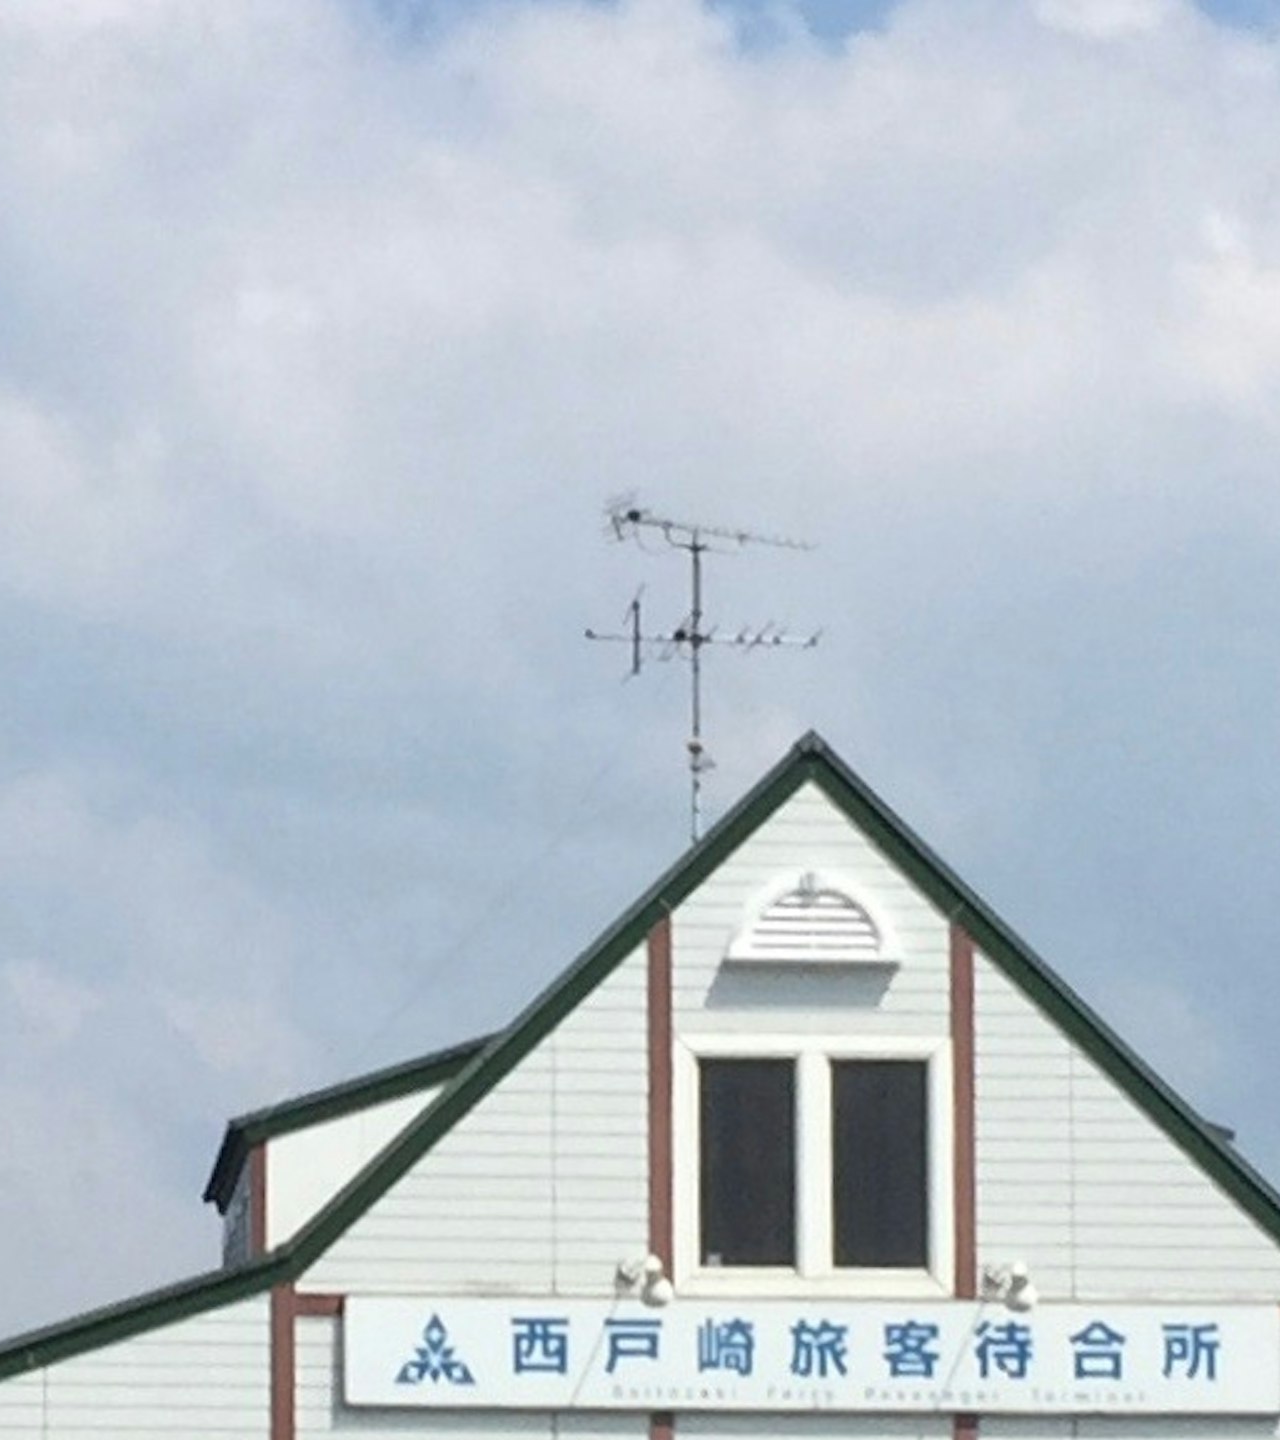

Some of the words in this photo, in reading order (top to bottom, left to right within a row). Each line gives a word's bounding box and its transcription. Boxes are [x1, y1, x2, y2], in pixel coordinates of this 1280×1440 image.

[511, 1316, 1222, 1381] 西戸崎旅客待合所
